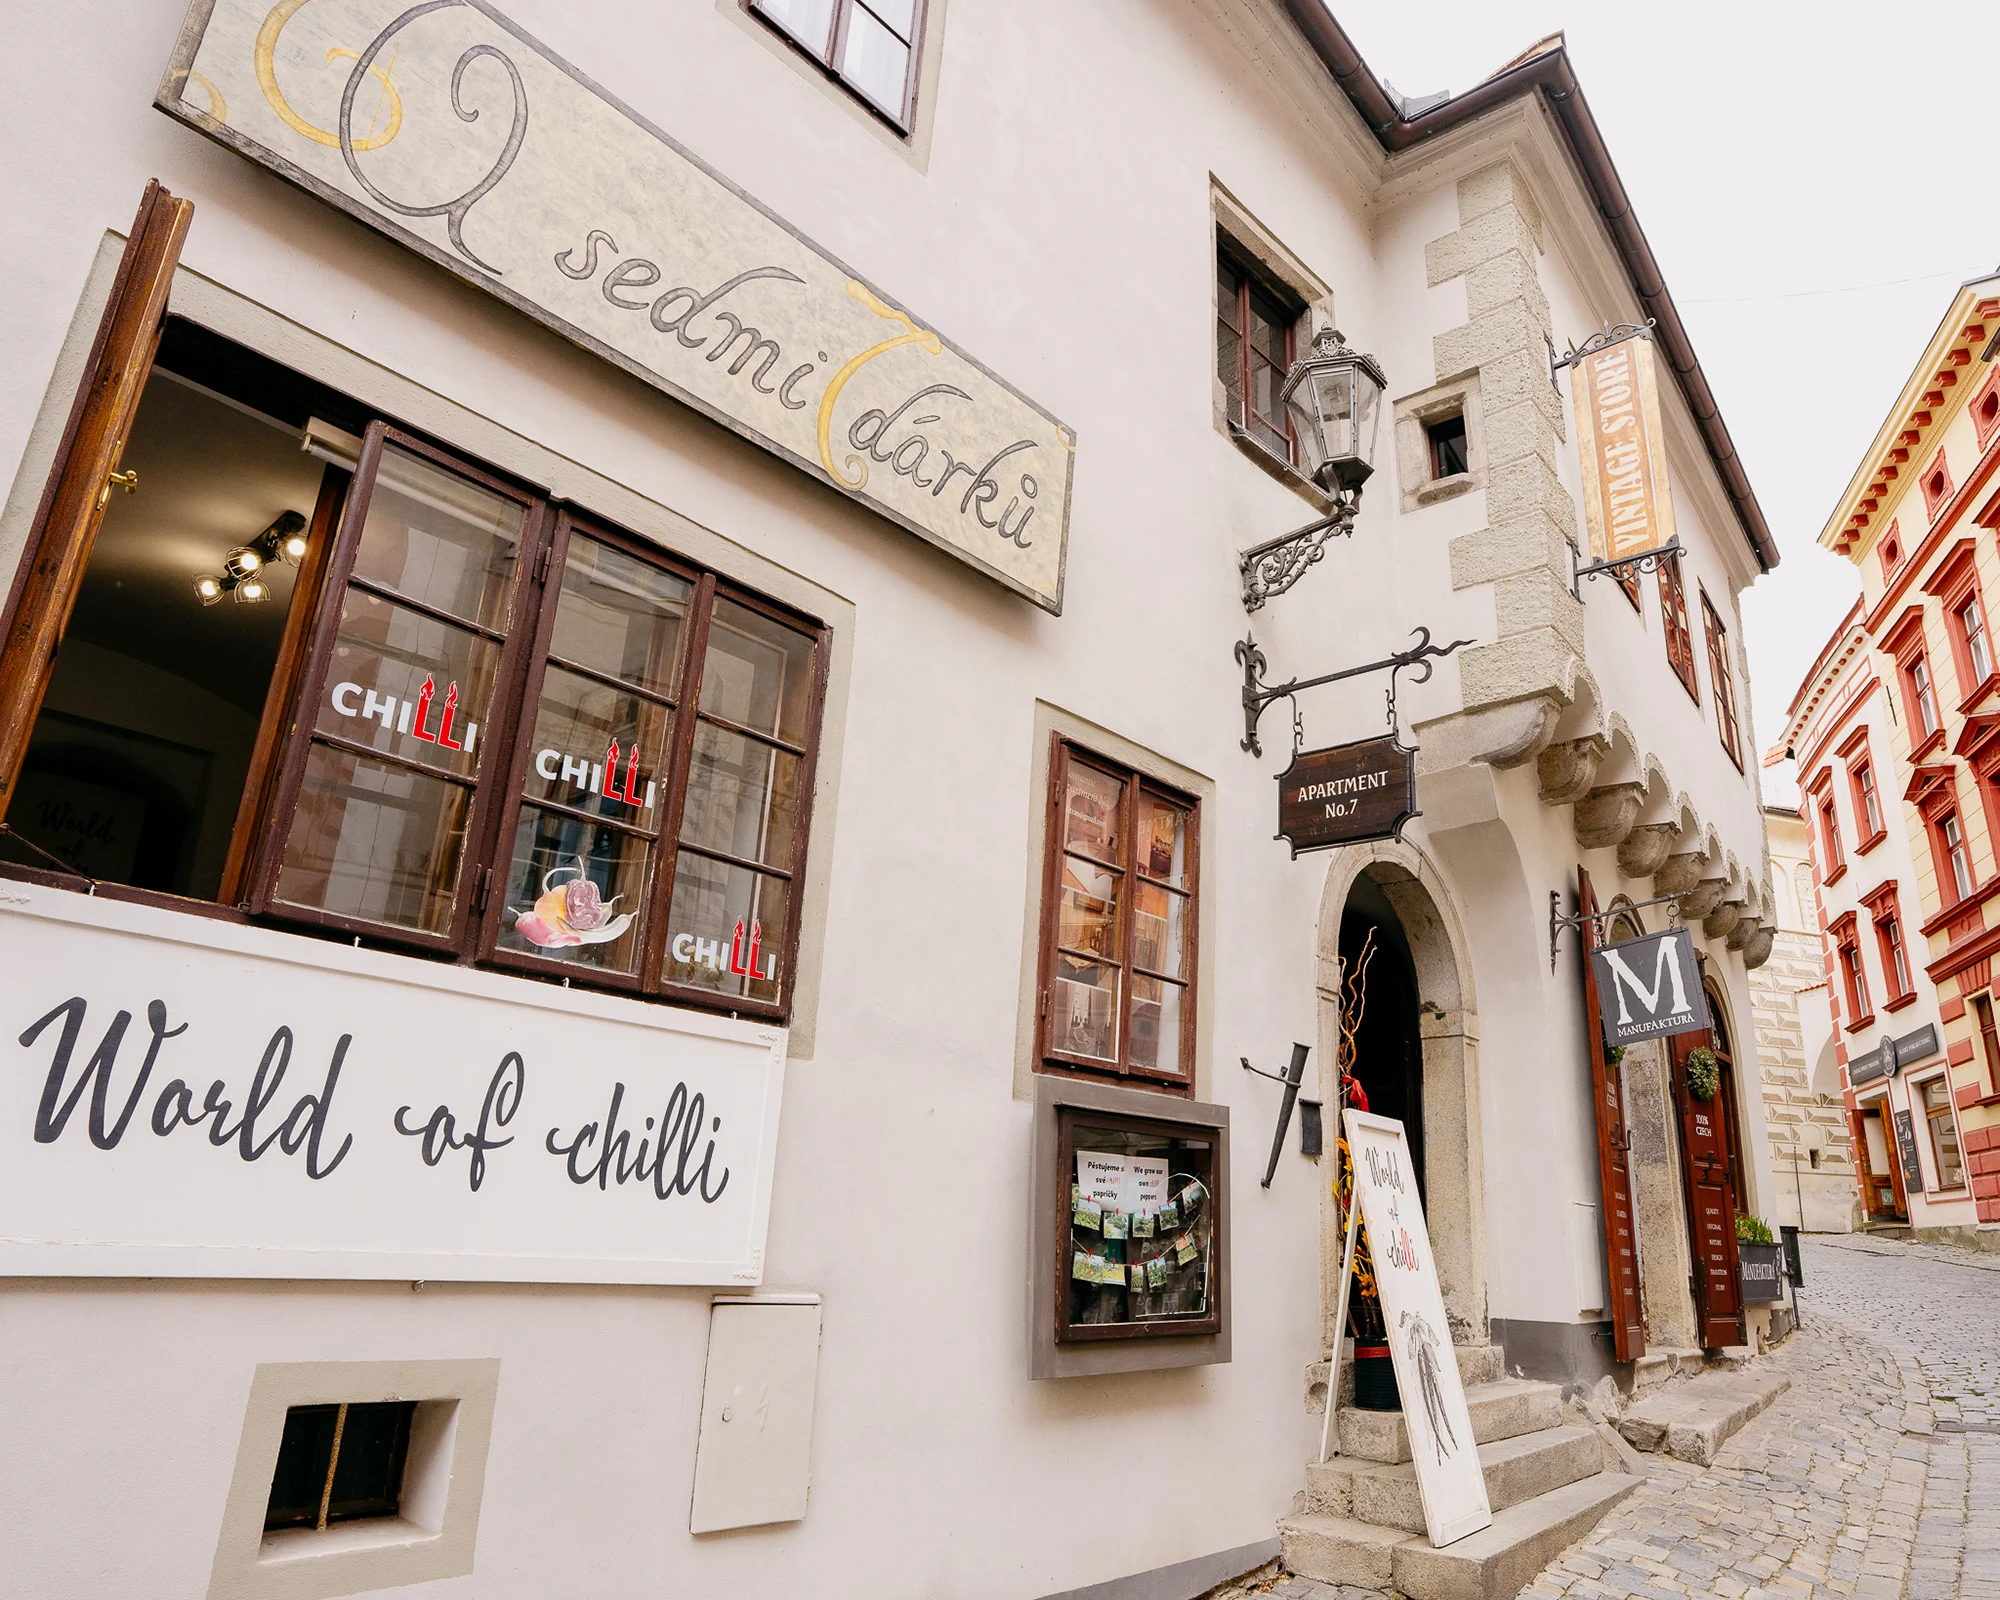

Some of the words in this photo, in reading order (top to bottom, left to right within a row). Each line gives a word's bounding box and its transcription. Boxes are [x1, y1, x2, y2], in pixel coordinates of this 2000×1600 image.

[554, 229, 829, 410] sedmi
[848, 383, 1039, 549] dárků
[1593, 348, 1637, 434] STORE
[1603, 436, 1649, 553] VINTAGE
[331, 673, 478, 753] CHILLI
[535, 737, 656, 809] CHILLI
[1297, 770, 1389, 802] APARTMENT
[1325, 799, 1358, 819] No.7
[672, 914, 777, 981] CHILLI
[1600, 936, 1693, 1026] M
[1616, 1012, 1696, 1038] MANUFAKTURA
[18, 996, 353, 1180] World
[393, 1051, 526, 1192] of
[545, 1081, 731, 1204] chilli
[1695, 1126, 1712, 1137] CZECH
[1087, 1161, 1120, 1173] Pěstujeme
[1133, 1166, 1143, 1174] We
[1365, 1146, 1405, 1194] World
[1387, 1227, 1419, 1271] chilli
